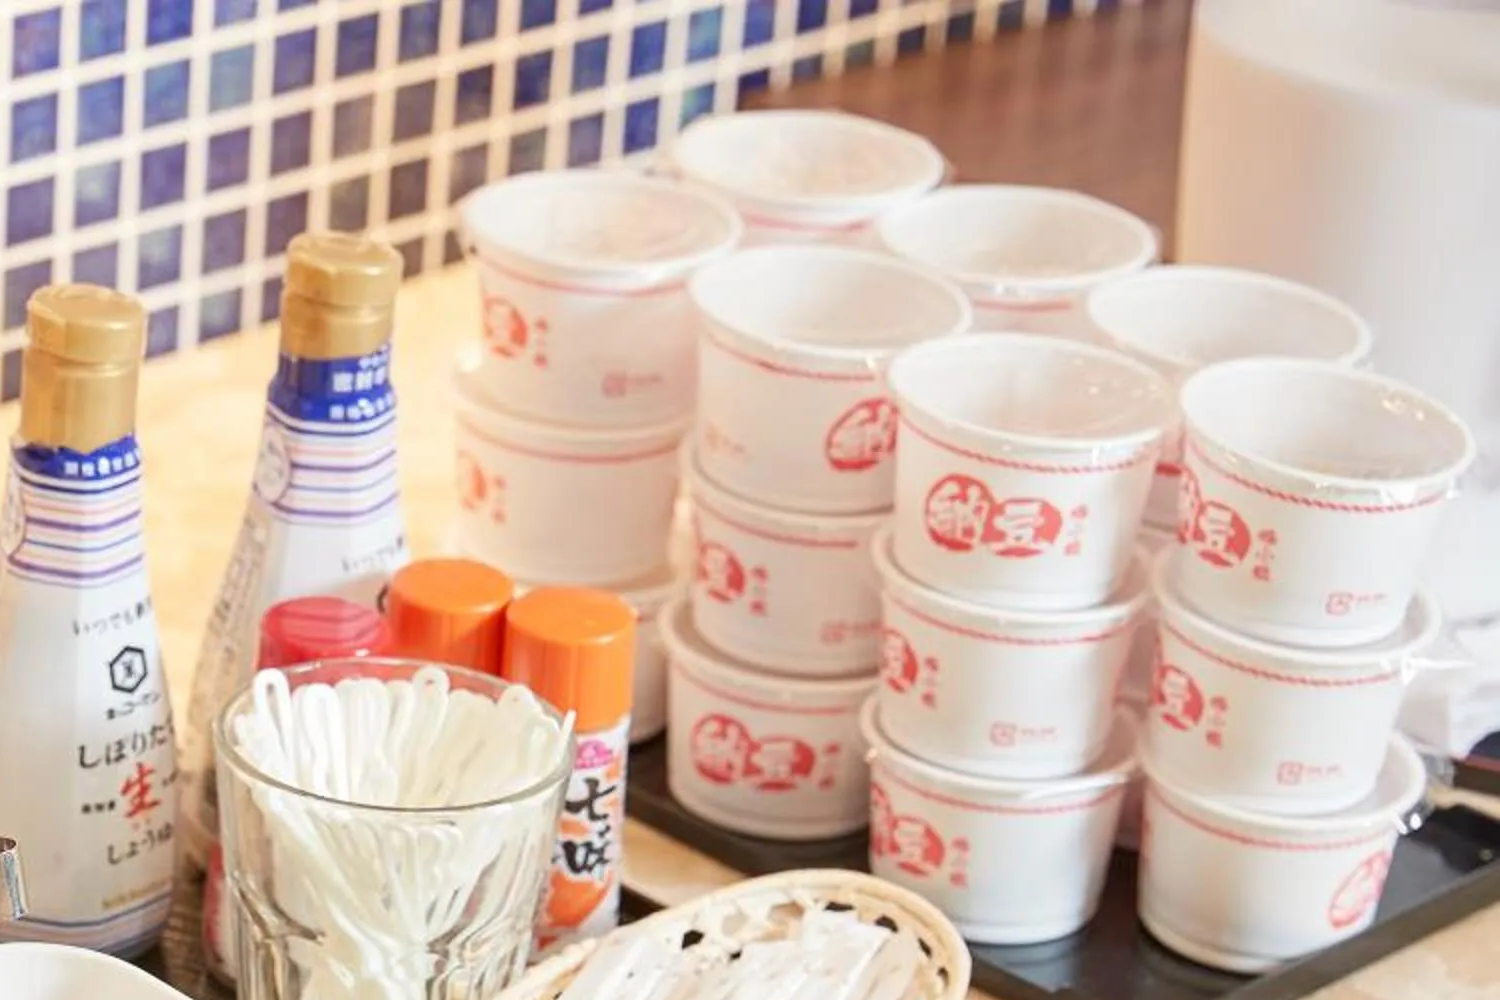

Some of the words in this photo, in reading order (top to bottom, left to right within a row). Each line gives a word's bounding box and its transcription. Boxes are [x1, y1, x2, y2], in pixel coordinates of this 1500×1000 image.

[924, 473, 1064, 558] 納豆
[1176, 462, 1252, 568] 豆
[78, 711, 175, 769] しぼりた
[119, 760, 164, 820] 生
